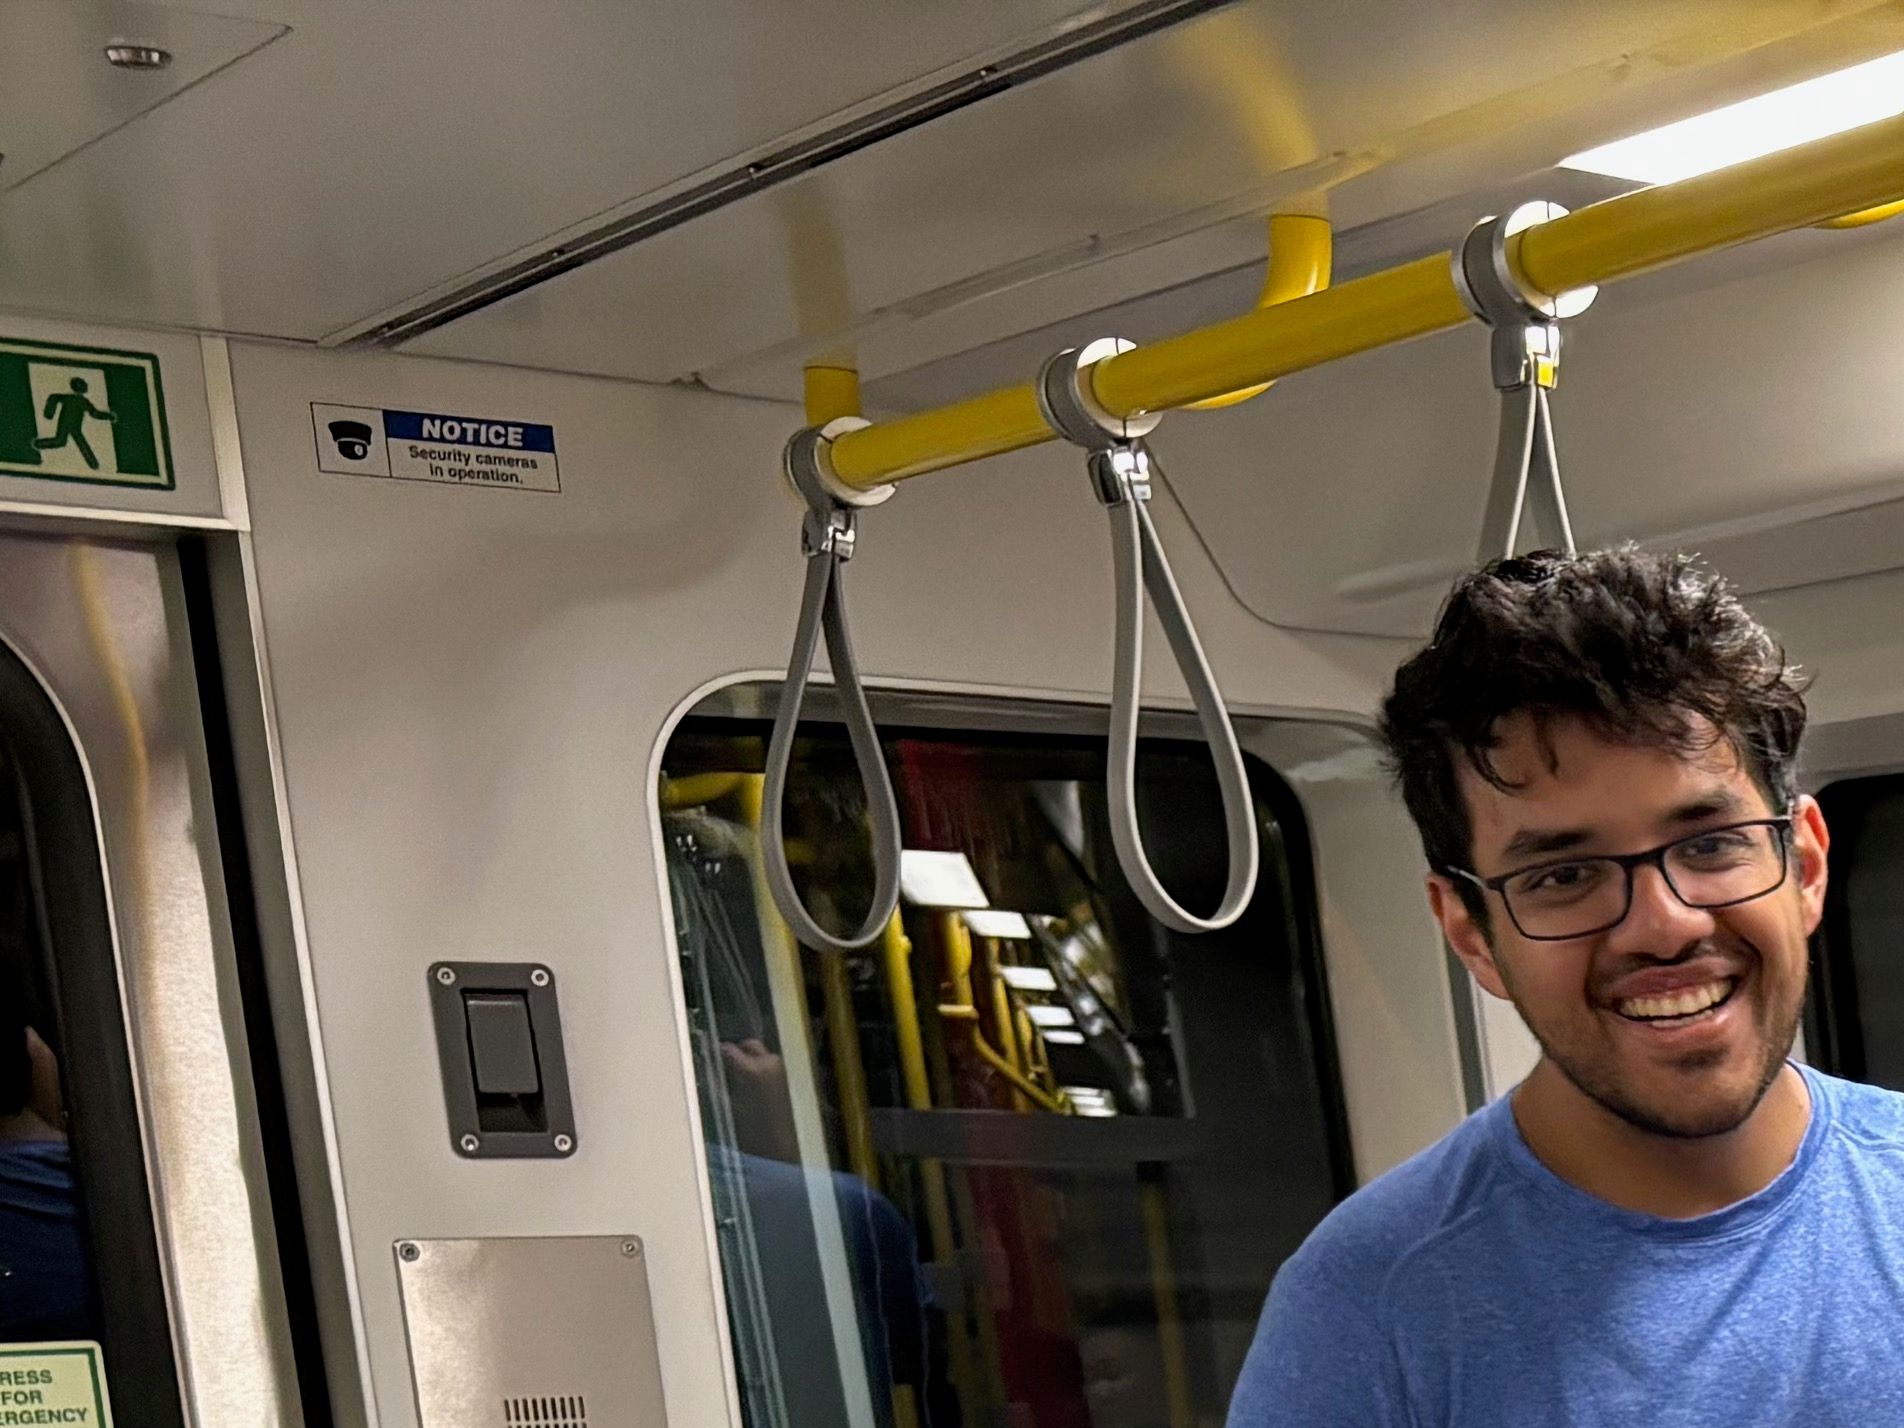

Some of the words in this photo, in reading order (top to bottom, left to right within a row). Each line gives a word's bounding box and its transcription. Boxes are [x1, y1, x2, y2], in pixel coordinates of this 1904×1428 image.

[422, 418, 523, 447] NOTICE
[409, 445, 471, 466] Security
[476, 450, 538, 469] cameras
[1, 1390, 43, 1406] FOR
[0, 1408, 88, 1425] RGENCY
